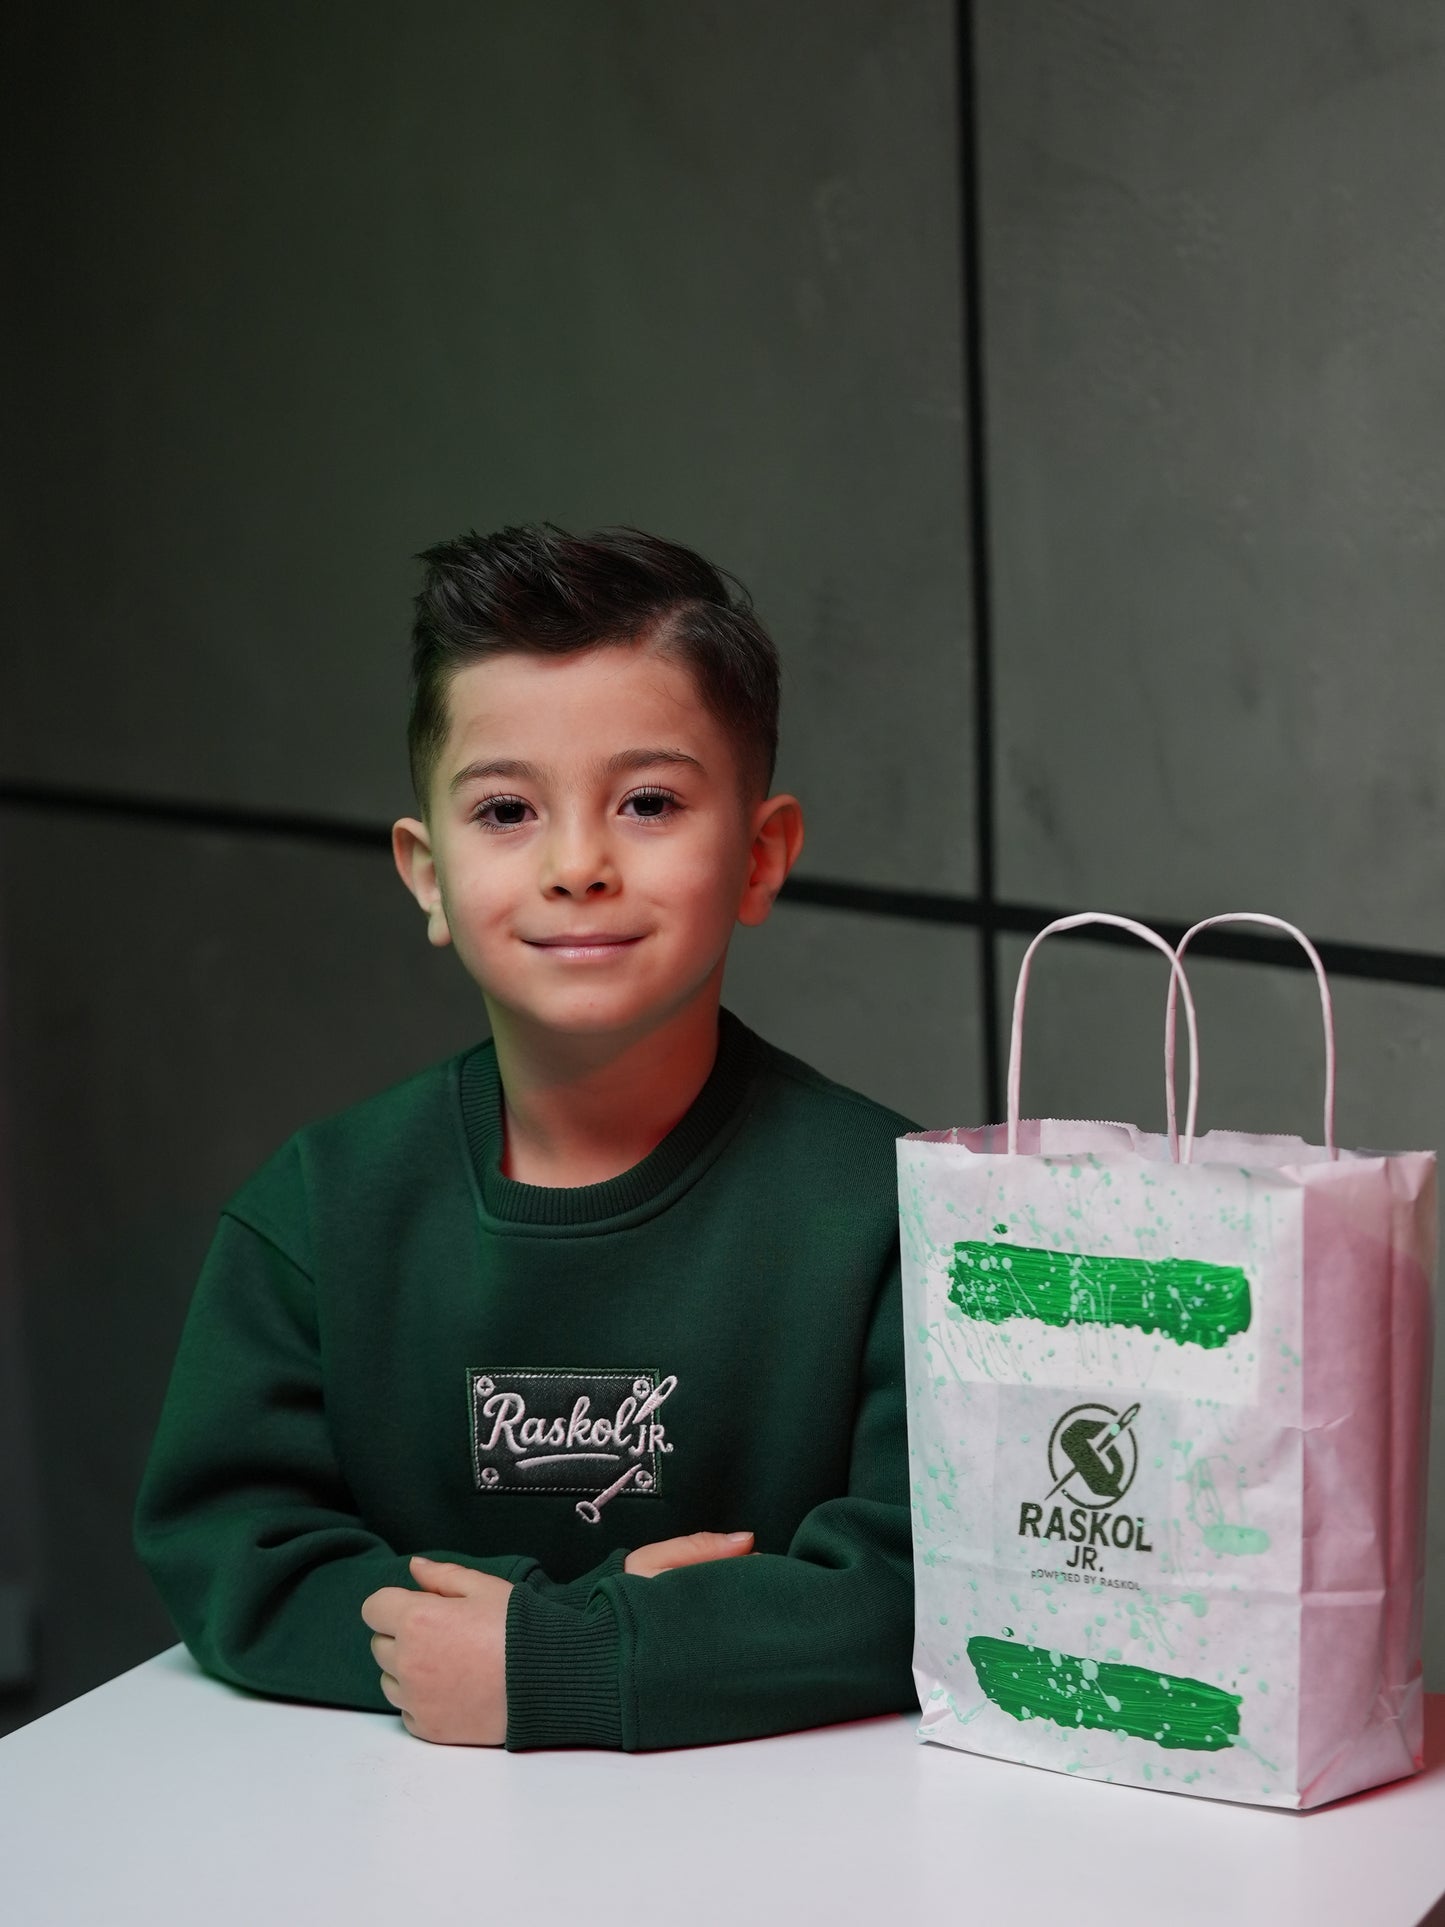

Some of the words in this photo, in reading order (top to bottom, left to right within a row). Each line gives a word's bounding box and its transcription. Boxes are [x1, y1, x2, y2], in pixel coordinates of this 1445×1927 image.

[480, 1392, 637, 1454] Raskol
[1018, 1502, 1153, 1552] RASKOL
[1066, 1545, 1104, 1573] JR.
[1084, 1574, 1097, 1585] BY
[1099, 1577, 1141, 1591] RASKOL
